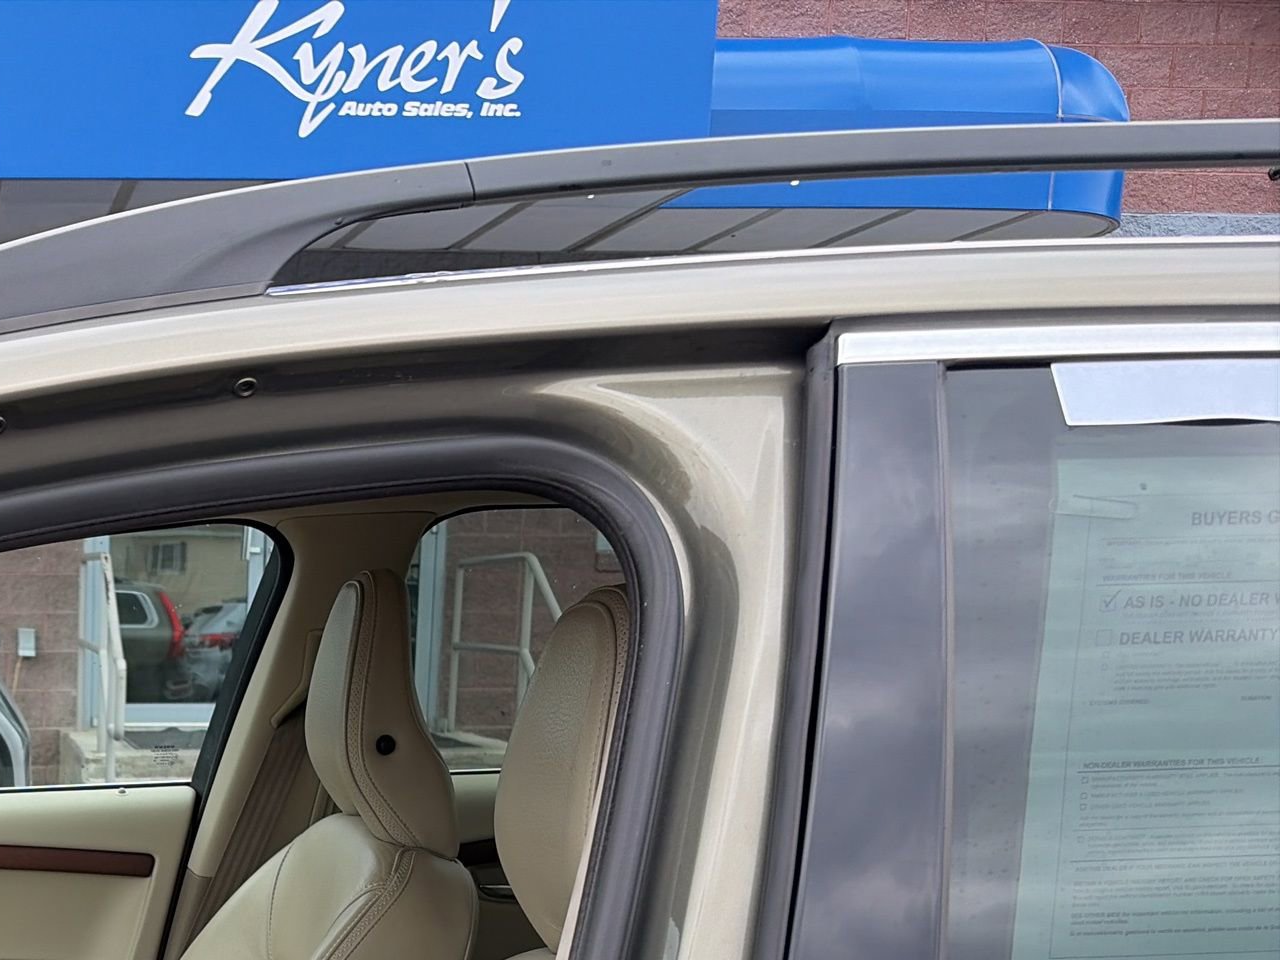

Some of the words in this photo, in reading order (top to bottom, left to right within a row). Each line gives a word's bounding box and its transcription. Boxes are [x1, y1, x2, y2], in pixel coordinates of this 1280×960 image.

[185, 0, 524, 138] Kyner's
[338, 101, 398, 117] Auto
[403, 101, 473, 118] Sales,
[480, 101, 521, 117] Inc.
[1191, 510, 1262, 526] BUYERS
[1123, 595, 1145, 609] AS
[1150, 594, 1165, 608] IS
[1178, 593, 1203, 607] NO
[1206, 592, 1270, 607] DEALER
[1119, 630, 1185, 645] DEALER
[1188, 628, 1278, 643] WARRANTY
